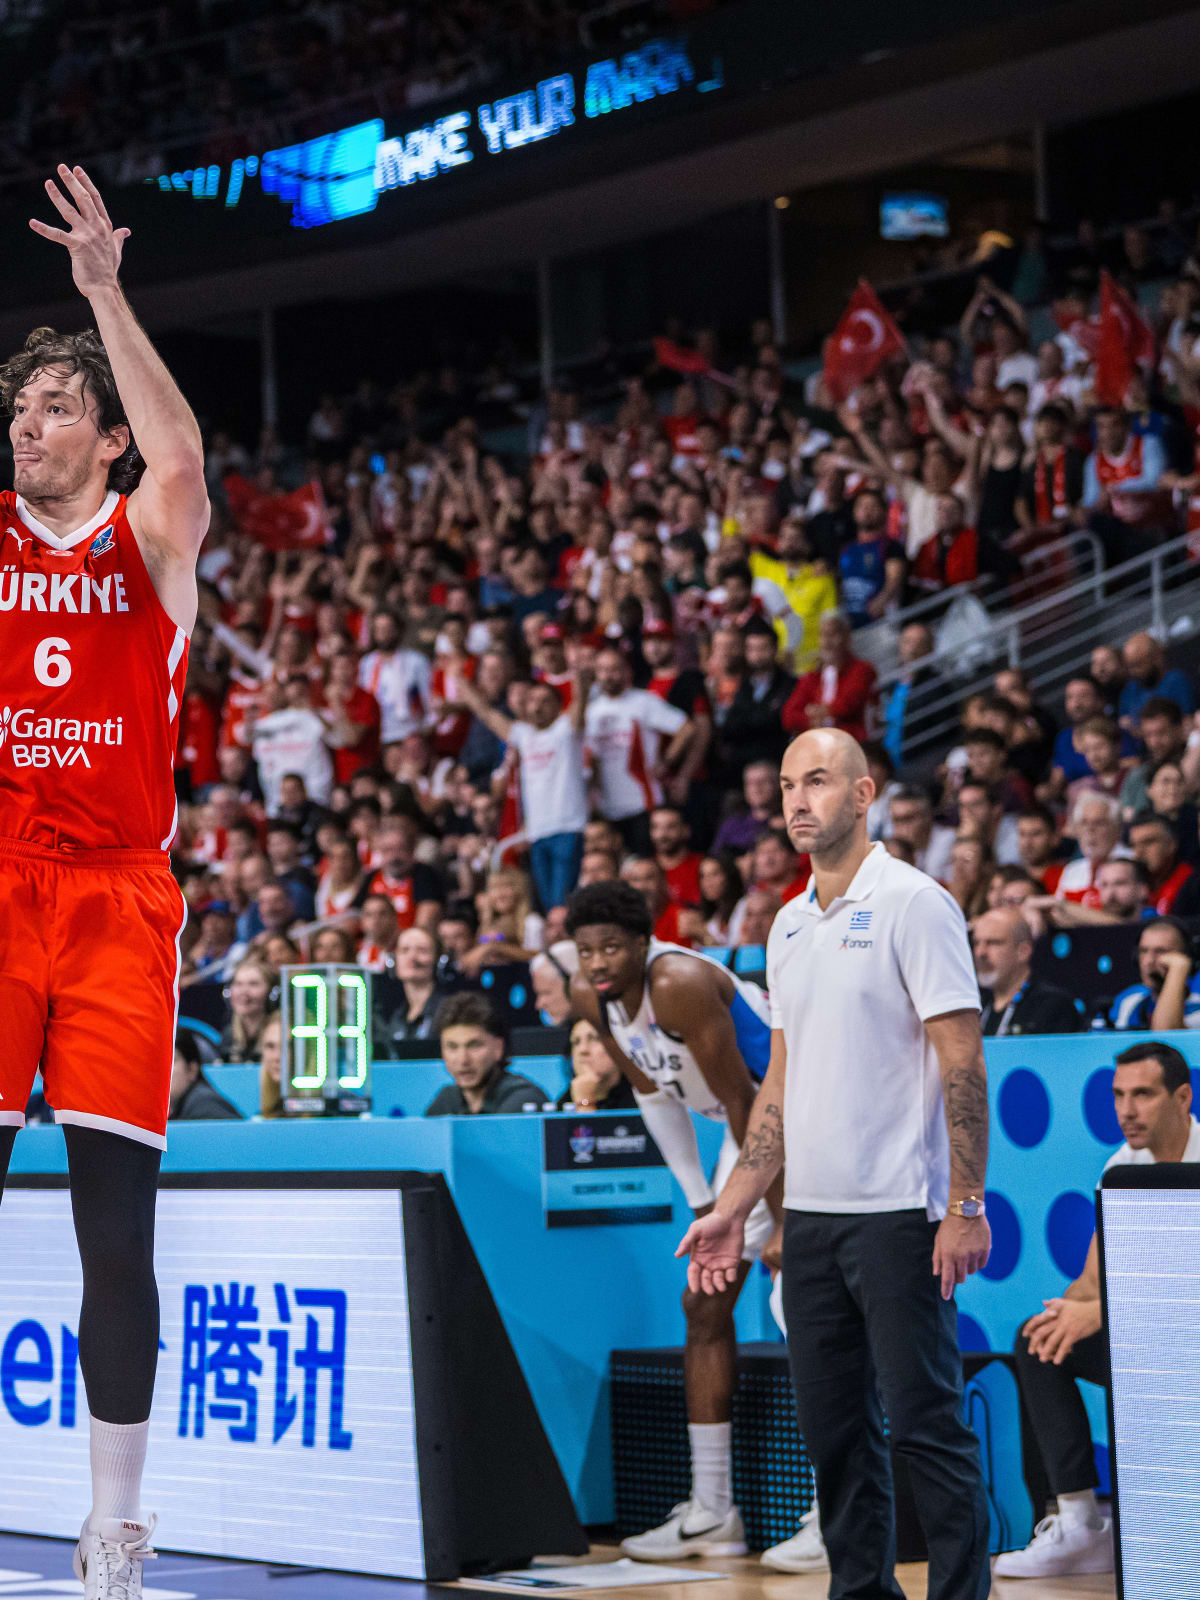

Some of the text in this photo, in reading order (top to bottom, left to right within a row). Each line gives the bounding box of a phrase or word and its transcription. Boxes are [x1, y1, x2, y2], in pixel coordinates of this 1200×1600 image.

[373, 110, 475, 193] MAKE
[478, 73, 576, 154] YOUR
[33, 637, 72, 687] 6
[11, 708, 123, 746] Garanti
[12, 745, 92, 769] BBVA
[178, 1281, 353, 1451] 腾讯
